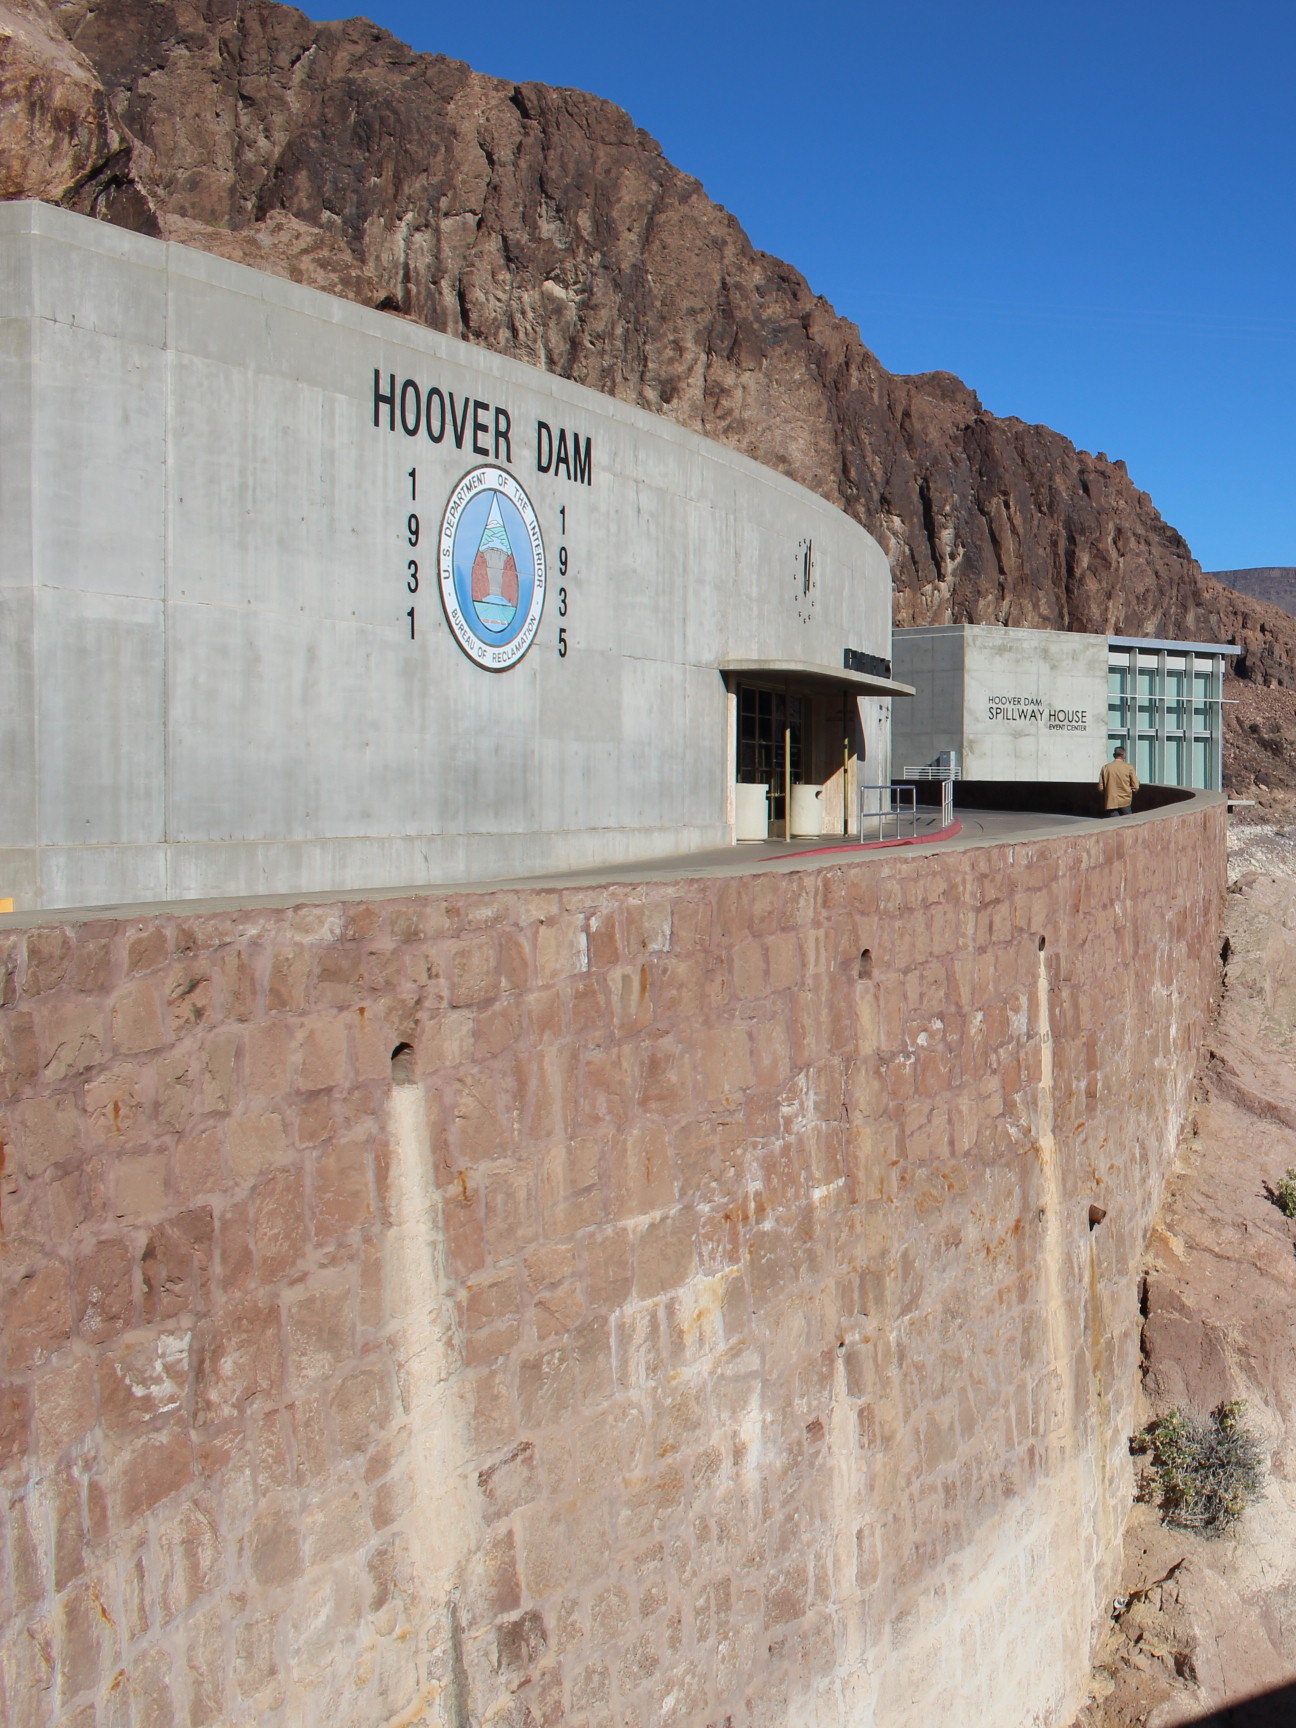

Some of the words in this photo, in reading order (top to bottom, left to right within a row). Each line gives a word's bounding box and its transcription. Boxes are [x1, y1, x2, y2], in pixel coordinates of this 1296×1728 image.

[373, 368, 513, 464] HOOVER
[537, 420, 592, 486] DAM
[407, 467, 420, 640] 1931
[444, 472, 487, 539] DEPARTMENT
[497, 474, 509, 488] OF
[514, 486, 529, 514] THE
[528, 519, 544, 589] INTERIOR
[558, 505, 568, 658] 1935
[451, 608, 476, 650] BUREAU
[477, 646, 488, 660] OF
[492, 614, 537, 664] RECLAMATION
[988, 696, 1022, 706] HOOVER
[1023, 697, 1043, 706] DAM
[988, 706, 1045, 721] SPILLWAY
[1048, 709, 1087, 723] HOUSE
[1048, 723, 1066, 731] EVENT
[1066, 724, 1087, 732] CENTER
